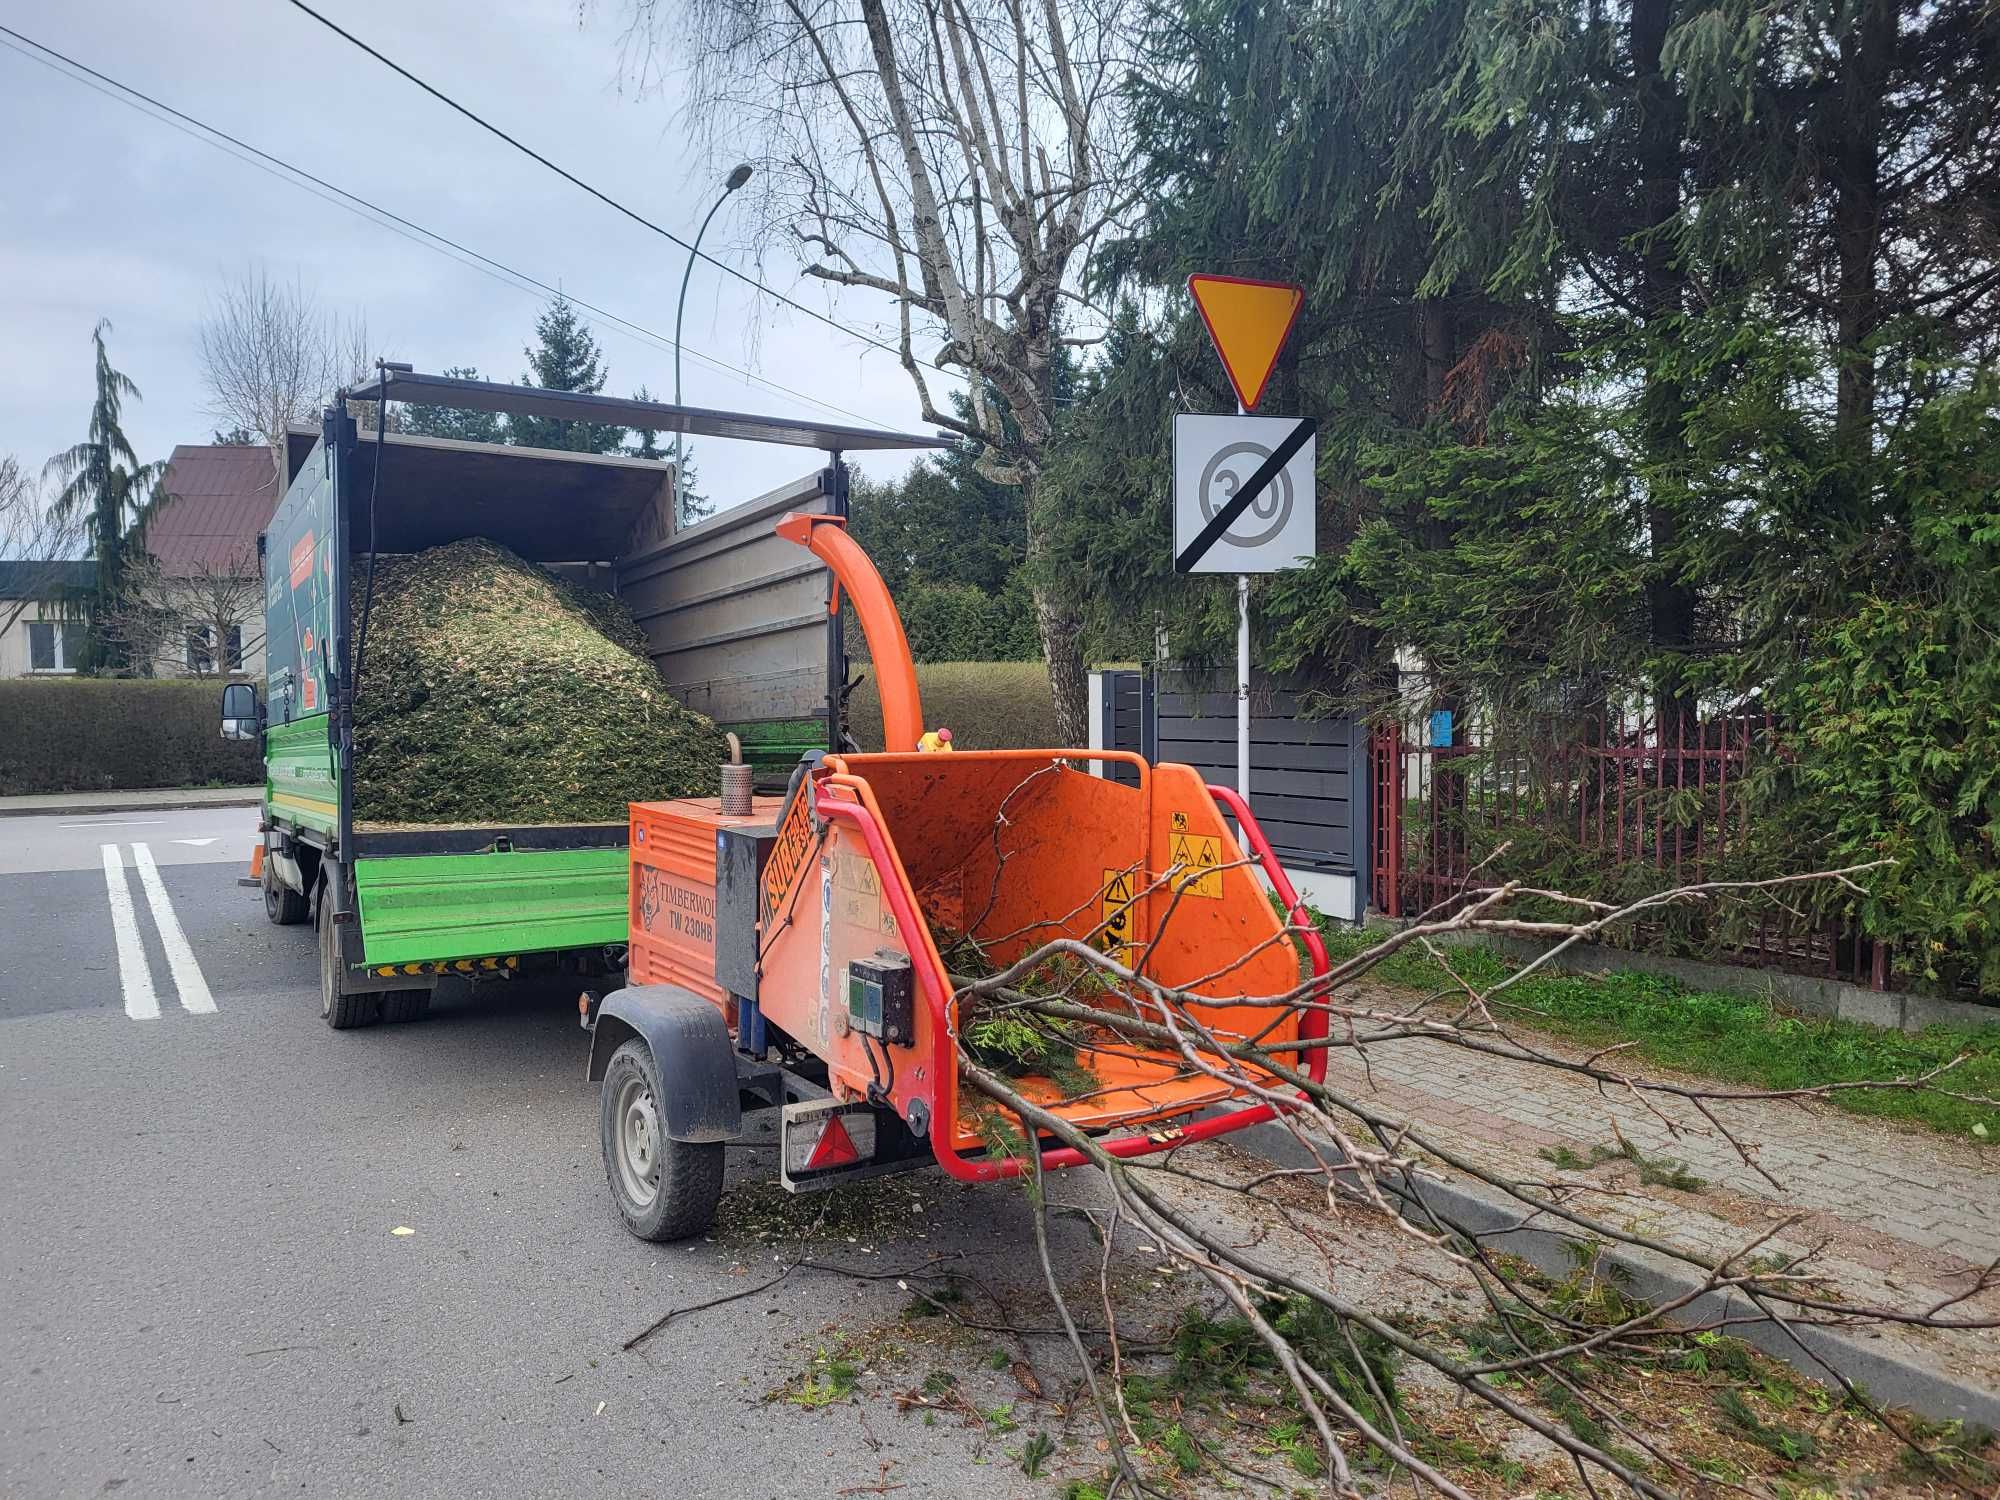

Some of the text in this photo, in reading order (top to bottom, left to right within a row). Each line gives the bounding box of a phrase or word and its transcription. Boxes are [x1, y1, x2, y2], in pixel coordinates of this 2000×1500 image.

[1212, 469, 1279, 520] 30
[669, 909, 713, 943] TW 230HB
